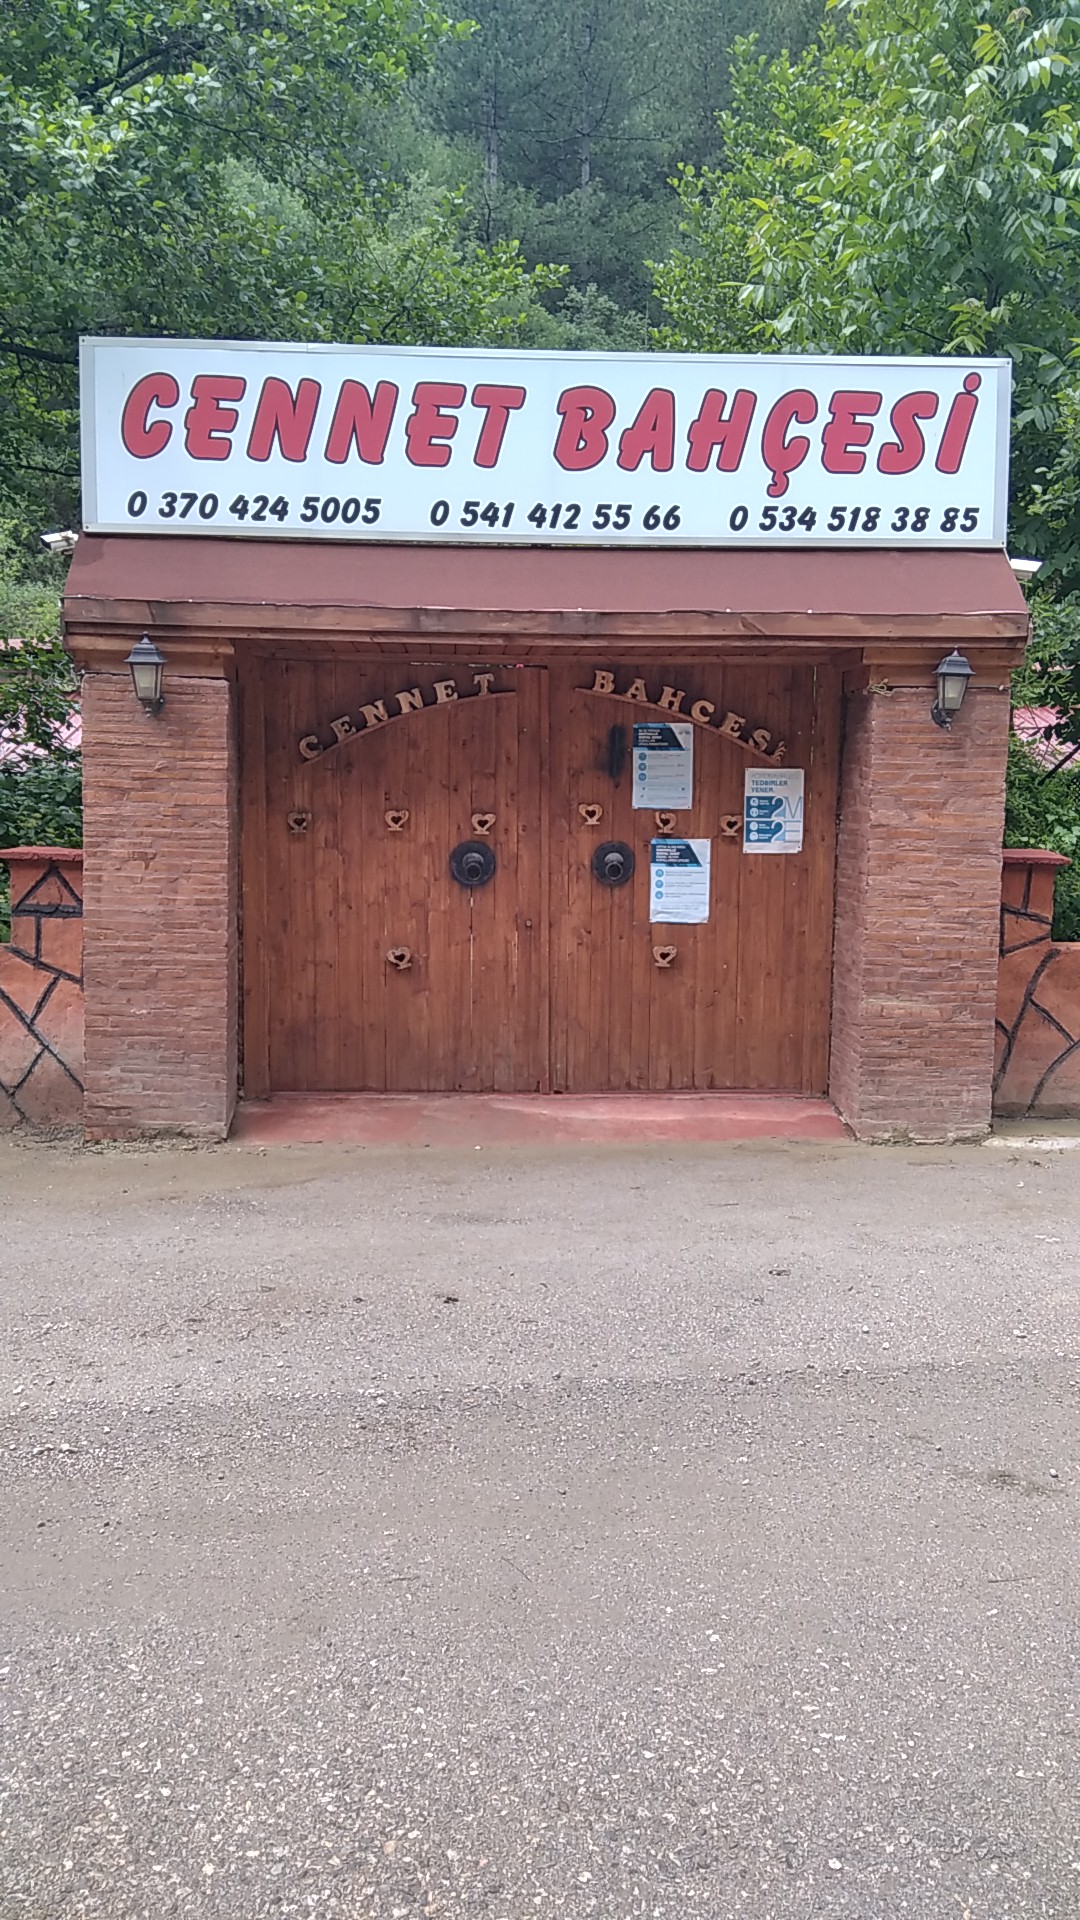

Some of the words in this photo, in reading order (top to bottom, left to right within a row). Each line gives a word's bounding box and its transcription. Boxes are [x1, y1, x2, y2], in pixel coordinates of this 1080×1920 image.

[121, 371, 527, 469] CENNET
[553, 371, 982, 499] BAHÇESİ
[127, 490, 148, 518] 0
[158, 491, 219, 520] 370
[229, 494, 290, 522] 424
[299, 496, 382, 525] 5005
[430, 499, 450, 527] 0
[460, 500, 515, 528] 541
[526, 502, 581, 530] 412
[592, 503, 633, 531] 55
[642, 504, 681, 531] 66
[729, 505, 749, 532] 0
[758, 505, 817, 532] 534
[826, 506, 882, 533] 518
[890, 506, 931, 533] 38
[939, 507, 980, 533] 85
[299, 673, 495, 760] CENNET
